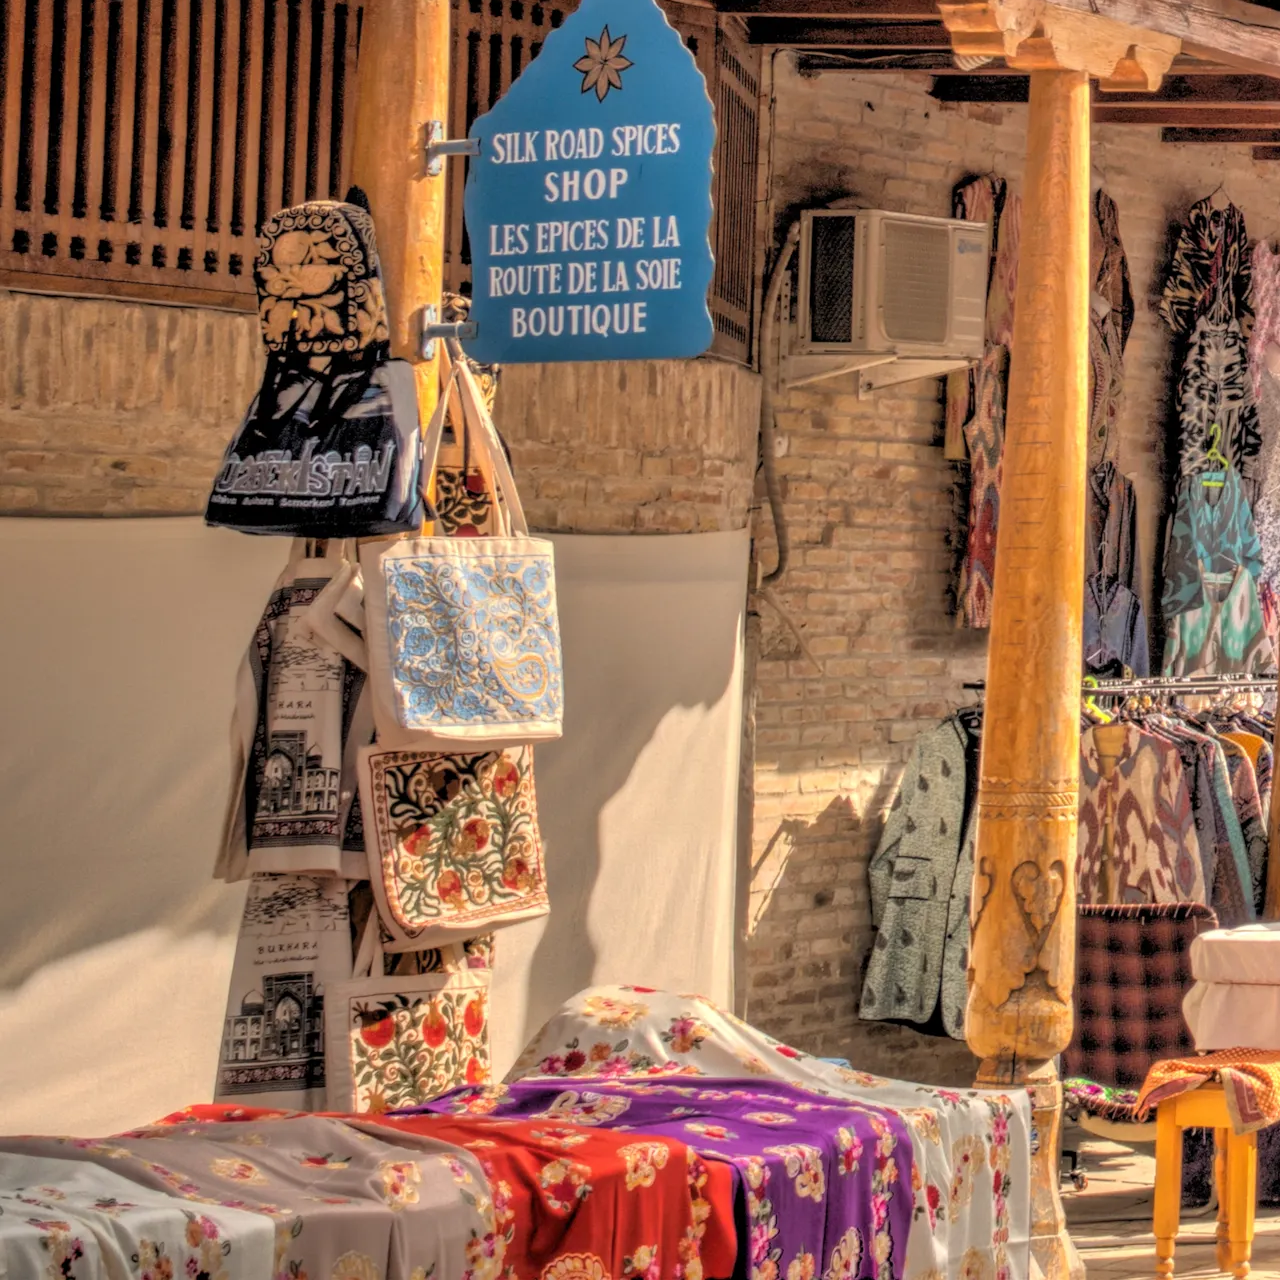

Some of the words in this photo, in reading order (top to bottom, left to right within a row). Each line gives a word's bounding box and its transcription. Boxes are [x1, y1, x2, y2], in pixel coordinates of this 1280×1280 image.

[491, 129, 539, 164] SILK
[544, 127, 604, 161] ROAD
[611, 123, 682, 157] SPICES
[544, 168, 629, 203] SHOP
[489, 223, 530, 256] LES
[536, 218, 609, 253] EPICES
[616, 216, 645, 250] DE
[652, 214, 681, 248] LA
[488, 262, 562, 298] ROUTE
[567, 261, 598, 295] DE
[603, 259, 630, 293] LA
[635, 257, 682, 291] SOIE
[511, 301, 647, 339] BOUTIQUE
[215, 436, 397, 497] UZBEKISTAN
[257, 941, 318, 955] BUKHARA
